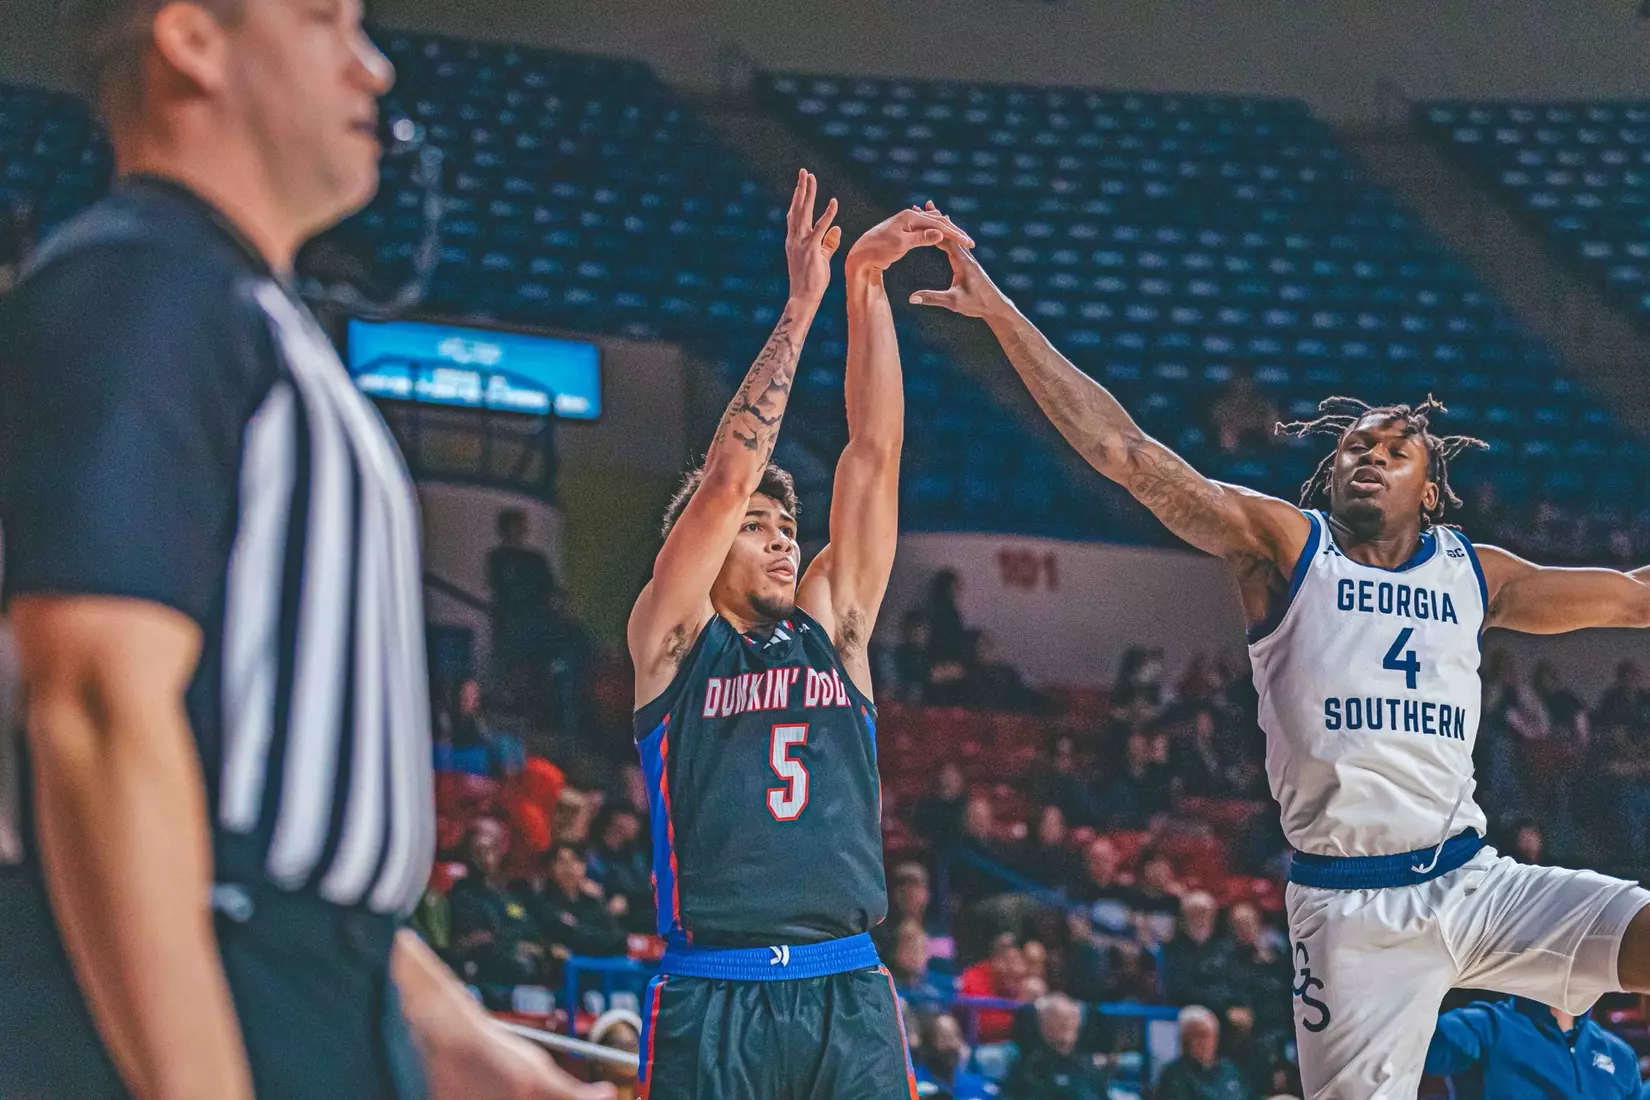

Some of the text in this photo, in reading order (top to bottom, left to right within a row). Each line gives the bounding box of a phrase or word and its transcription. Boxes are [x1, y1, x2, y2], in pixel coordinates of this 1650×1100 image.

[1337, 578, 1458, 624] GEORGIA
[1382, 627, 1421, 689] 4
[702, 666, 800, 719] DUNKIN'
[1324, 697, 1465, 741] SOUTHERN
[766, 723, 809, 821] 5
